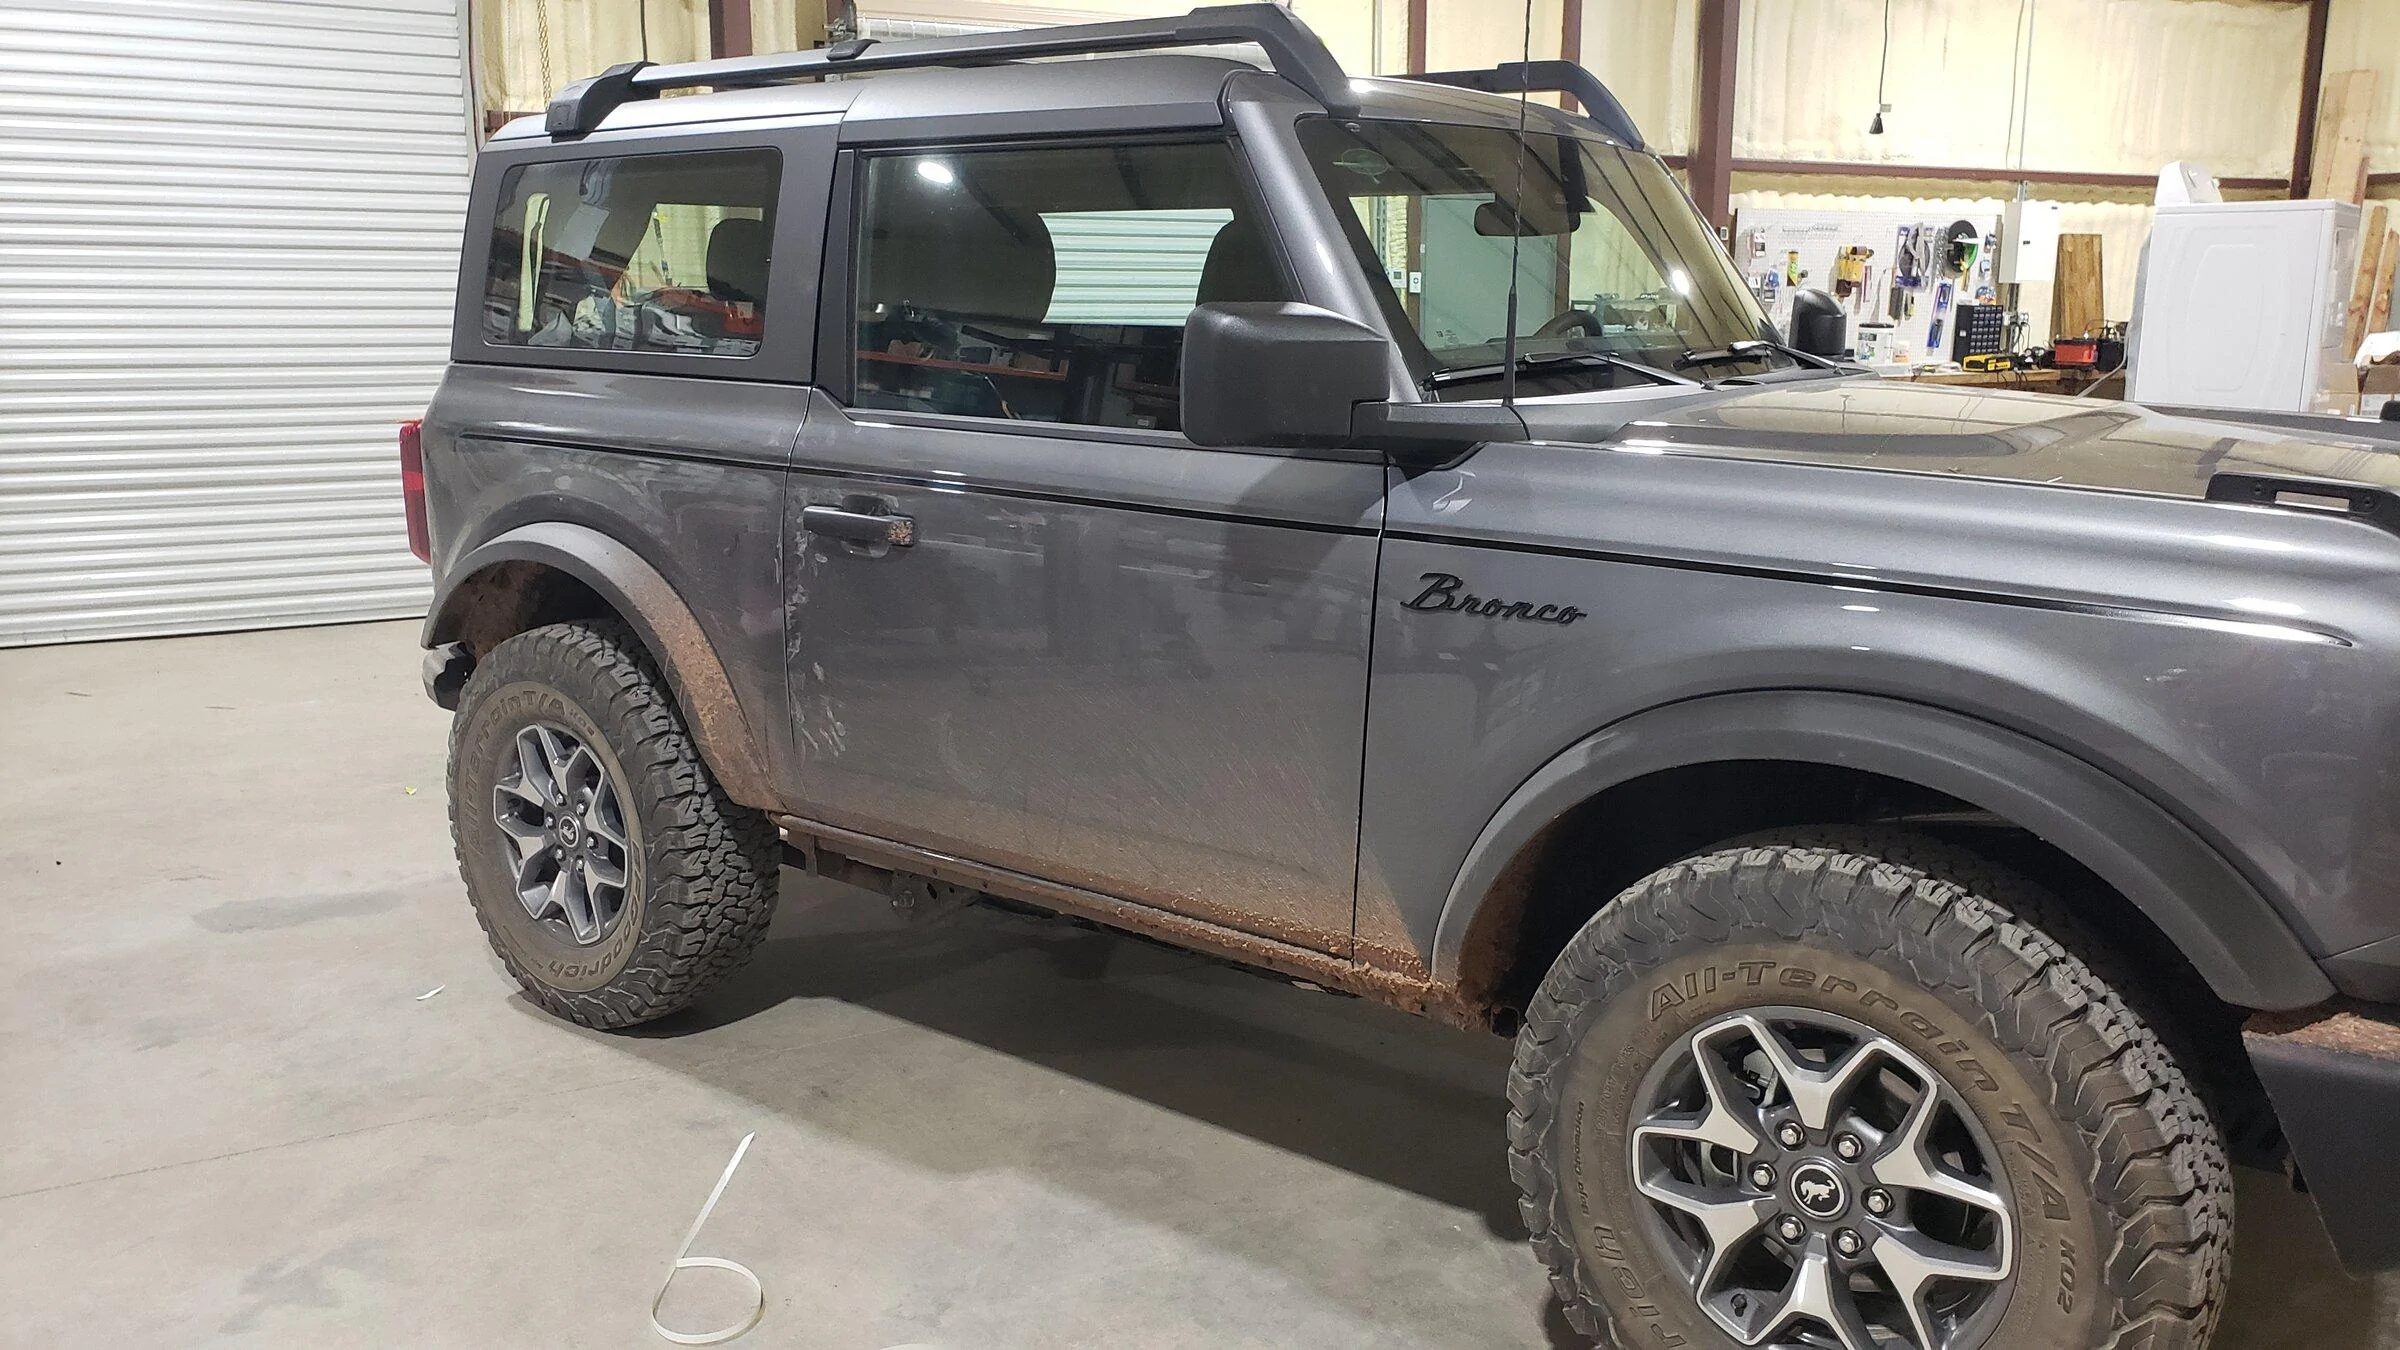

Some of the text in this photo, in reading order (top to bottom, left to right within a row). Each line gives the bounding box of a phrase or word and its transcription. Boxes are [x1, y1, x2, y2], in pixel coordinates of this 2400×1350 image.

[1400, 572, 1587, 625] Bronco
[466, 693, 522, 855] All-Terrain
[1573, 1099, 1585, 1178] Champion
[1651, 961, 1999, 1093] All-Terrain
[2000, 1101, 2071, 1221] T/A
[1594, 1225, 1688, 1349] rich
